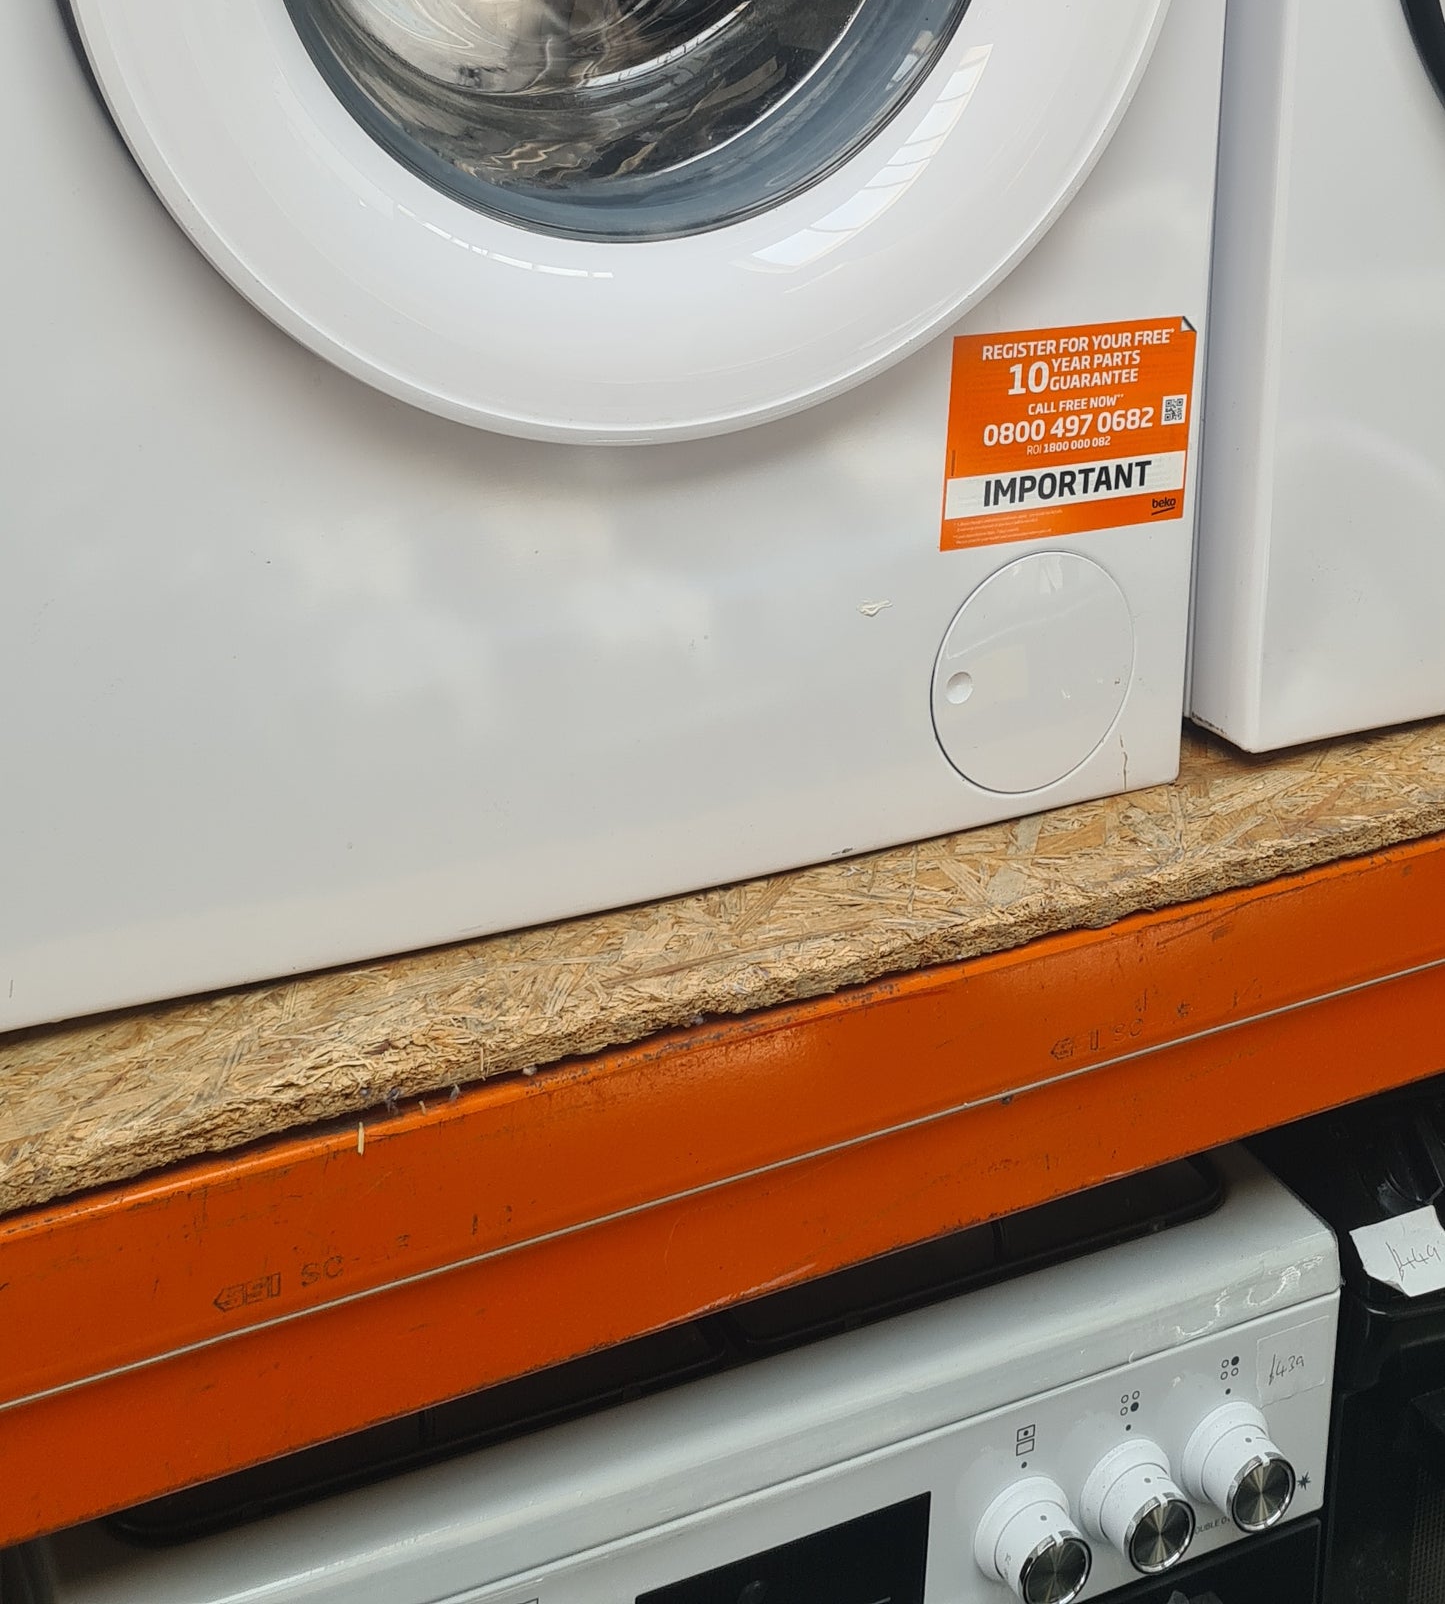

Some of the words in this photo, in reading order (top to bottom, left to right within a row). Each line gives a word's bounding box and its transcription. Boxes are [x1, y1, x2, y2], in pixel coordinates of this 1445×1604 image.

[982, 340, 1056, 361] REGISTER
[1060, 337, 1089, 353] FOR
[1092, 333, 1132, 350] YOUR
[1051, 355, 1091, 373] YEAR
[1094, 350, 1141, 368] PARTS
[1007, 361, 1049, 395] 10
[1050, 368, 1139, 391] GUARANTEE
[1028, 401, 1056, 416] CALL
[1059, 398, 1087, 412] FREE
[983, 419, 1045, 446] 0800
[1050, 412, 1093, 438] 497
[1097, 406, 1154, 433] 0682
[1026, 444, 1042, 456] ROI
[1043, 441, 1069, 454] 1800
[1070, 438, 1091, 451] 000
[1092, 436, 1111, 448] 082
[983, 460, 1152, 507] IMPORTANT
[1151, 497, 1176, 509] beko
